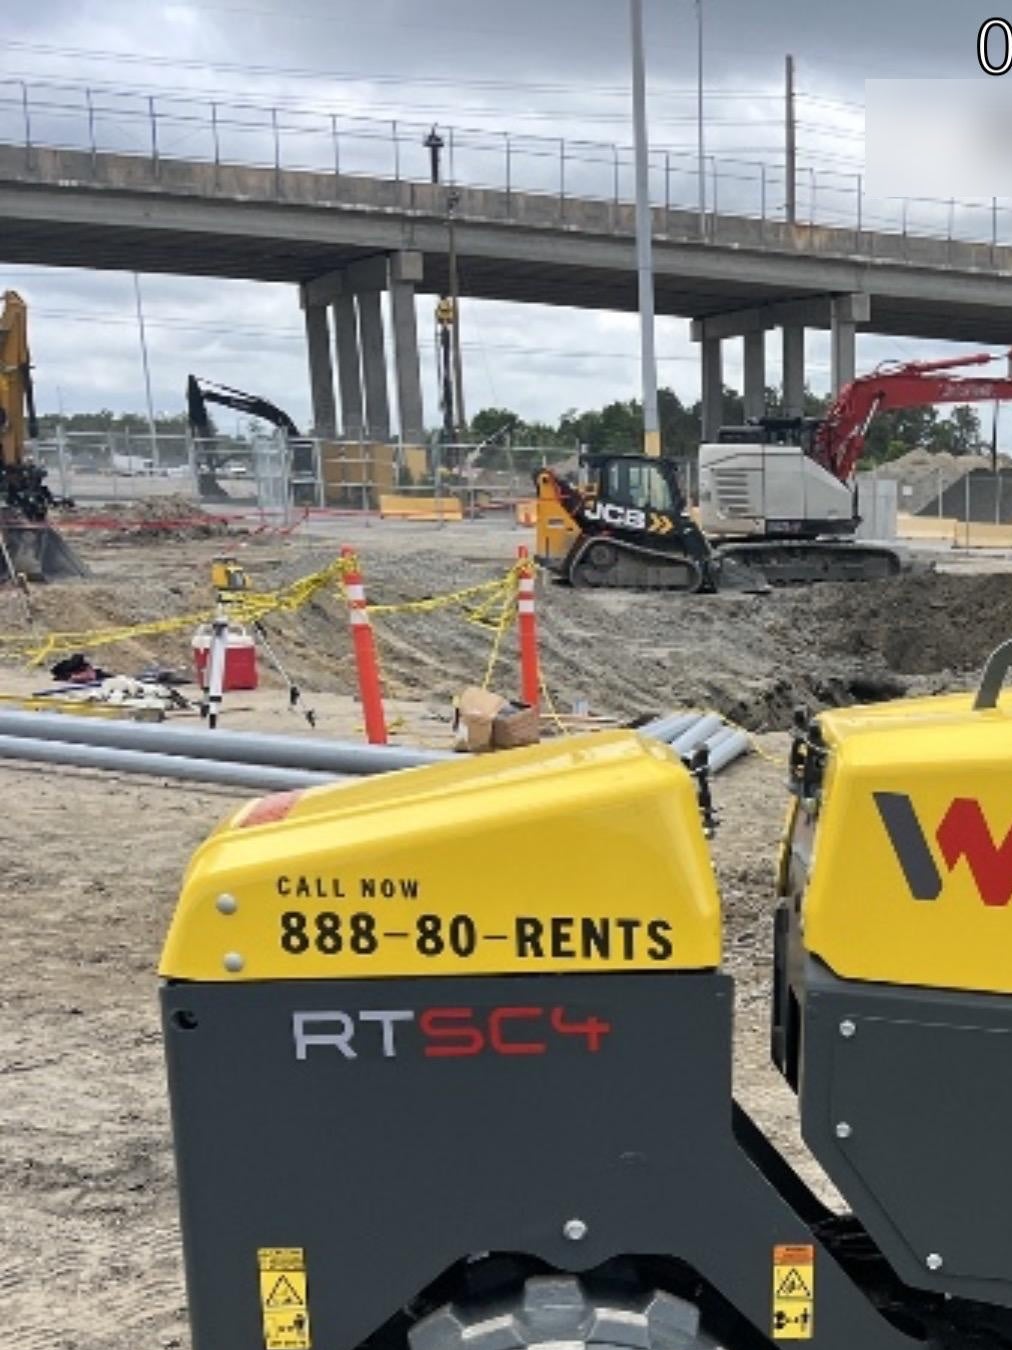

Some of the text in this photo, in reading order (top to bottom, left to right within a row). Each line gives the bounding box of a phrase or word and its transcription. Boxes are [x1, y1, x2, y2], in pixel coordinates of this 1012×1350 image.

[584, 502, 646, 529] JCB
[277, 876, 420, 898] CALL NOW
[280, 911, 673, 960] 888-80-RENTS
[292, 1006, 612, 1060] RTSC4
